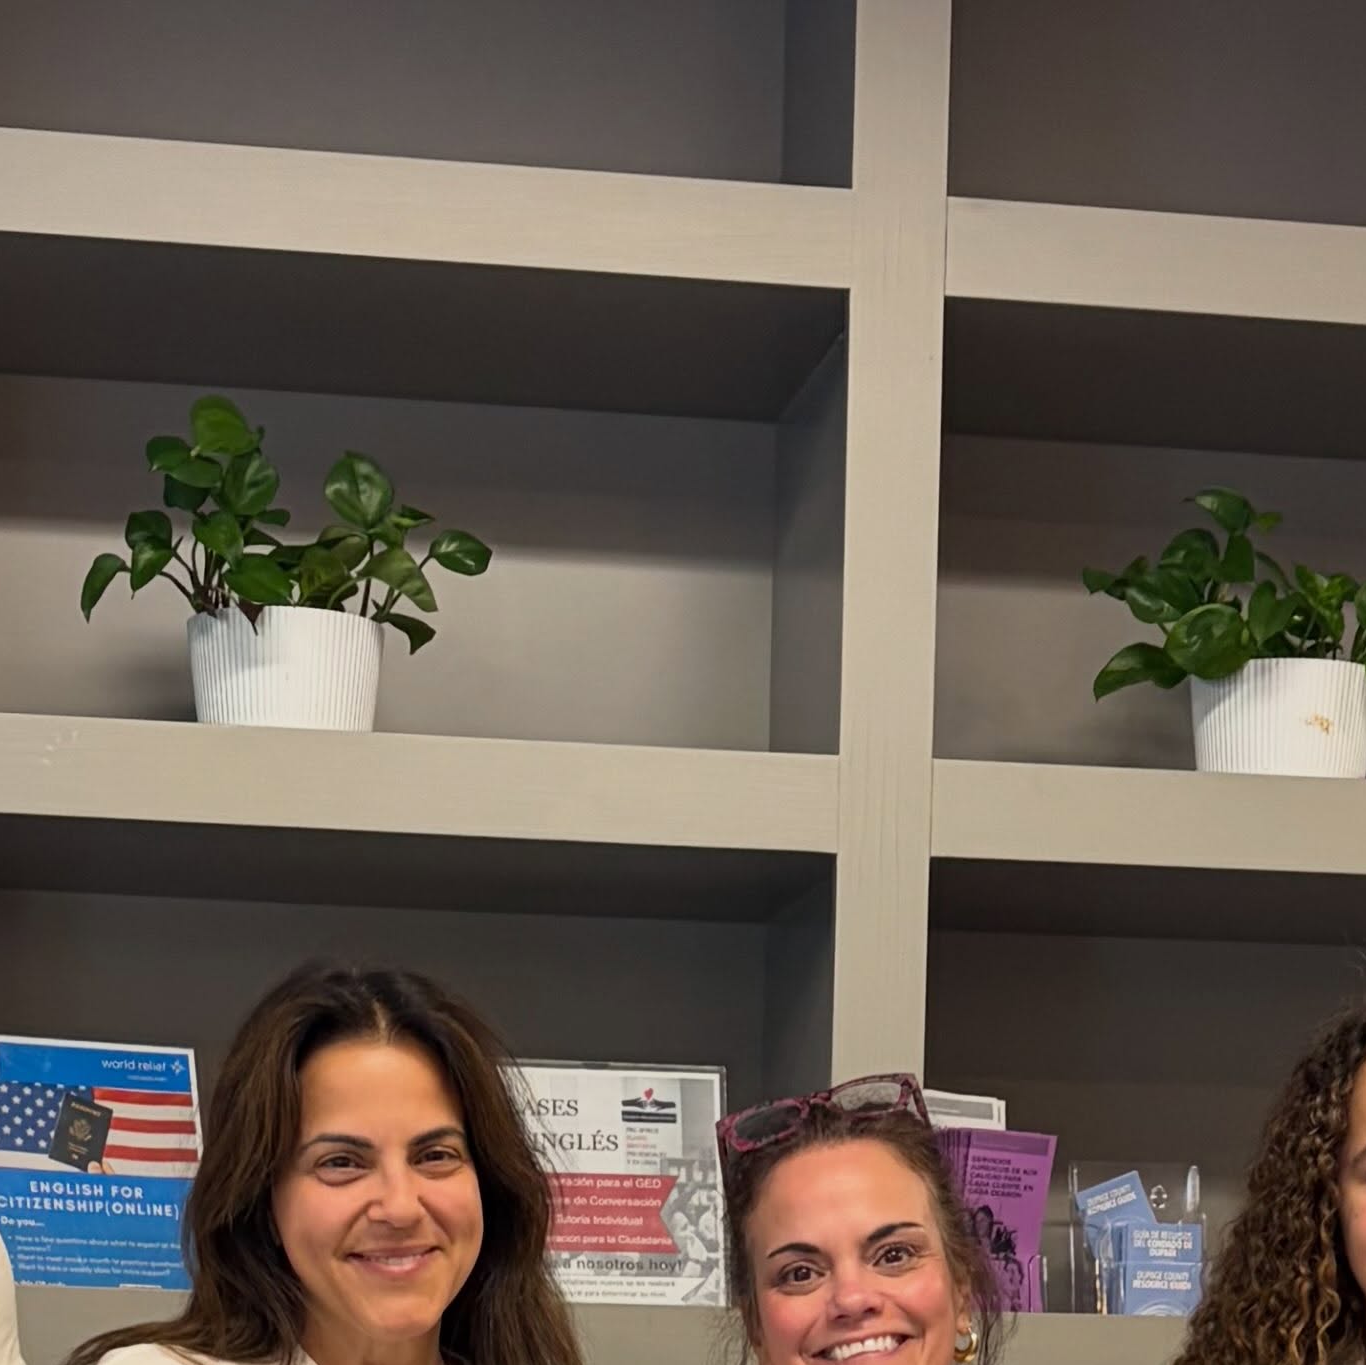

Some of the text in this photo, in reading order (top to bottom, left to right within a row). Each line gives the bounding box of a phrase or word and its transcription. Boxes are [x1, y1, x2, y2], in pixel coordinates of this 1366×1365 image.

[101, 1059, 166, 1072] world relief
[597, 1178, 661, 1188] para el GED
[30, 1181, 143, 1199] ENGLISH FOR
[577, 1260, 644, 1271] nosotros
